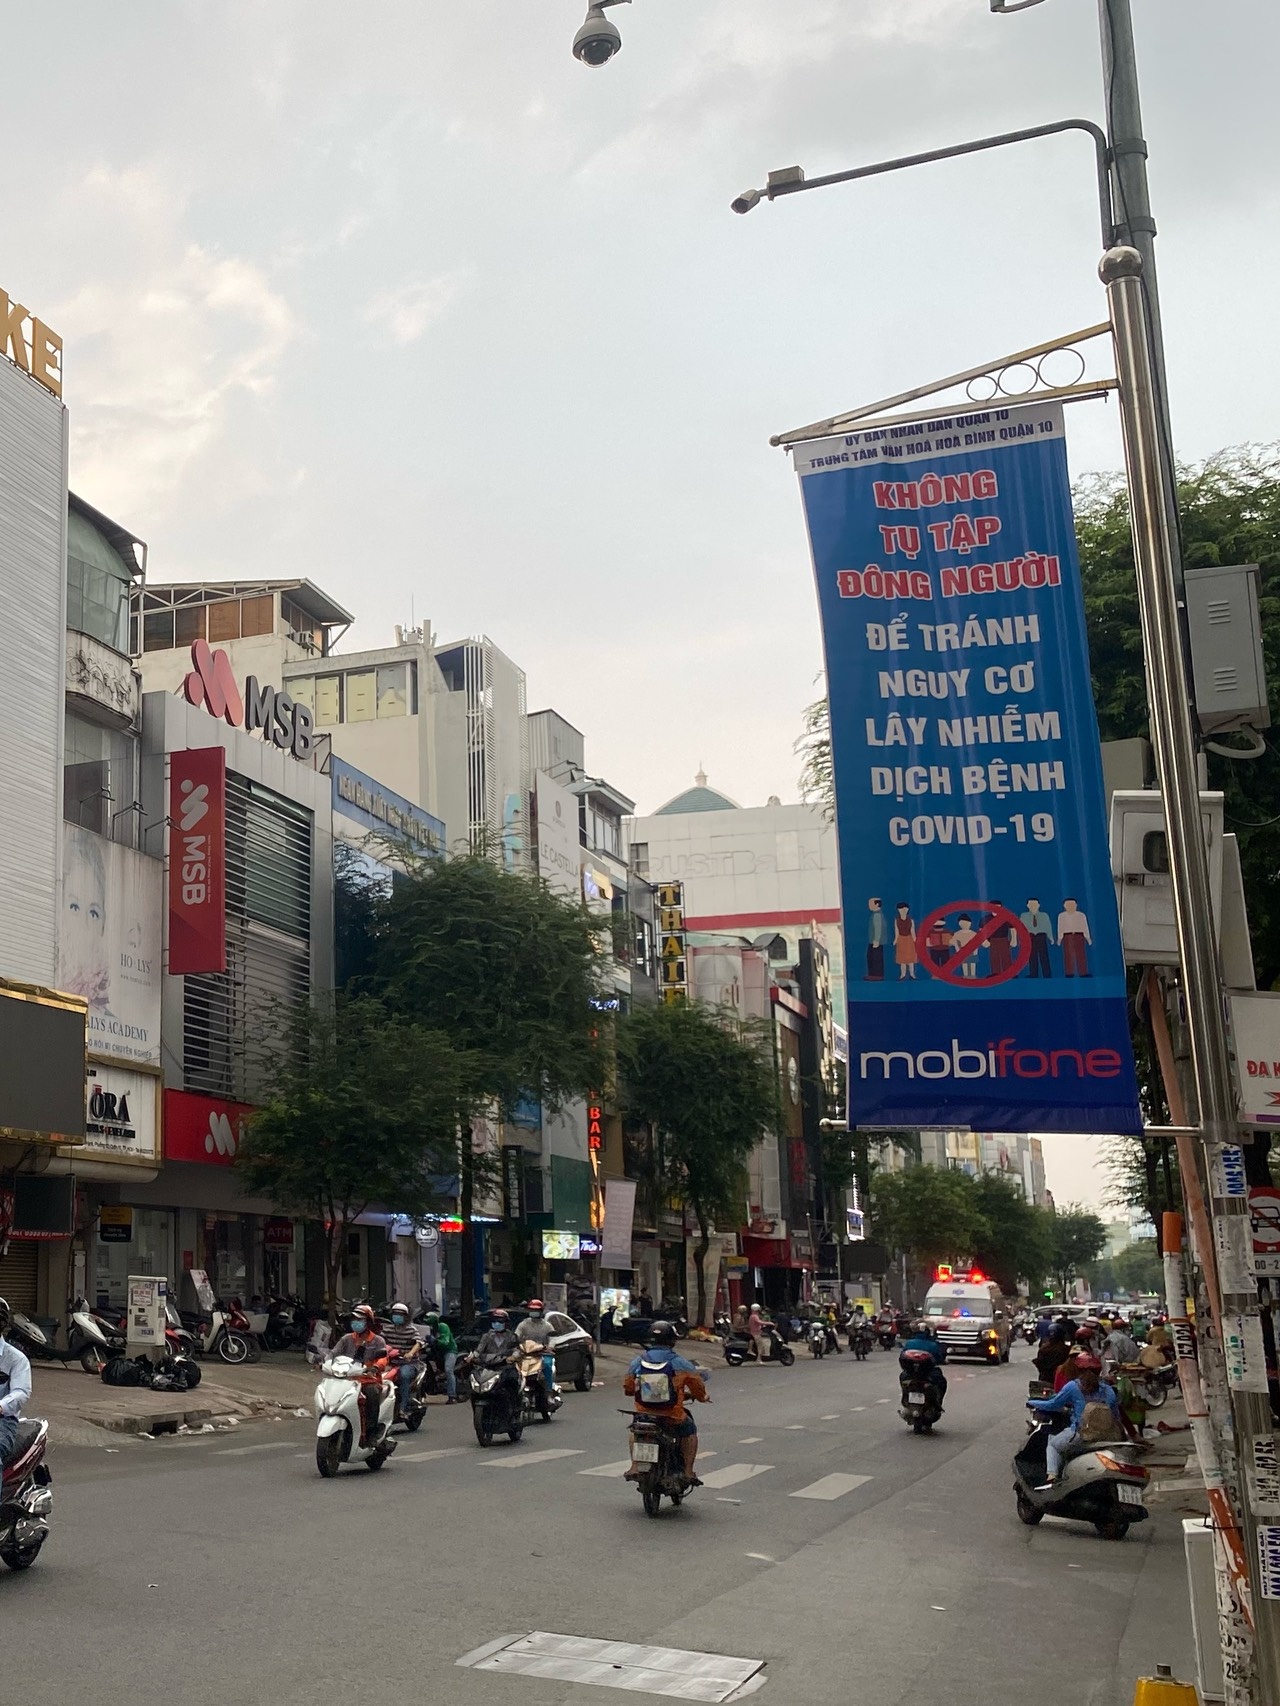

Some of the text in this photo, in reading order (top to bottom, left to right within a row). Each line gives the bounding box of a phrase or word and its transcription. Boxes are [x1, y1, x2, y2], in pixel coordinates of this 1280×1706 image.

[995, 409, 1009, 421] 10
[809, 452, 849, 468] TRUNG
[964, 429, 995, 445] BÌNH
[999, 423, 1034, 440] QUẬN
[1038, 420, 1053, 433] 10
[873, 470, 998, 509] KHÔNG
[880, 514, 1001, 559] TỤ TẬP
[837, 552, 1061, 600] ĐÔNG NGƯỜI
[866, 612, 1040, 652] ĐỂ TRÁNH
[878, 661, 1035, 699] NGUY CƠ
[245, 675, 315, 760] MSB
[865, 704, 1061, 747] LÂY NHIỄM
[871, 758, 1066, 802] DỊCH BỆNH
[889, 812, 1056, 847] COVID-19
[182, 834, 206, 906] MSB
[107, 1020, 149, 1042] ACADEMY
[860, 1037, 1122, 1079] mobifone
[1247, 1060, 1270, 1076] ĐA
[267, 1226, 294, 1238] ATM
